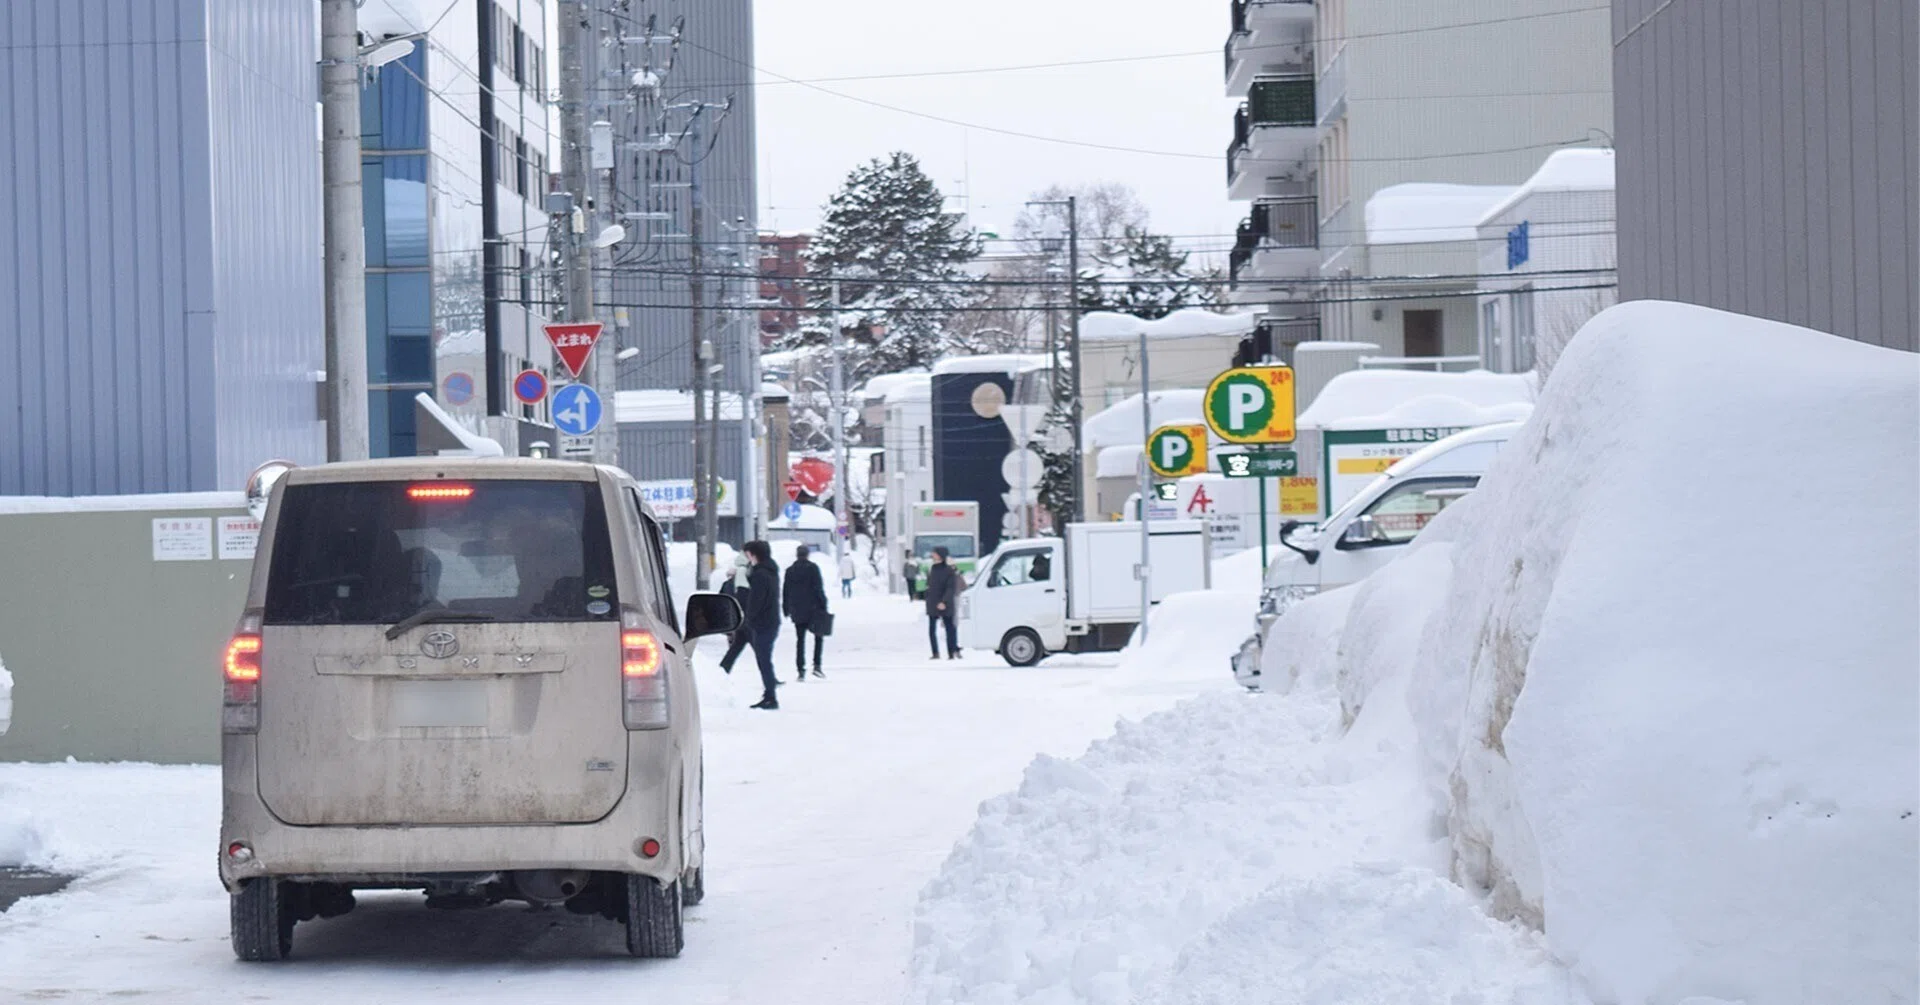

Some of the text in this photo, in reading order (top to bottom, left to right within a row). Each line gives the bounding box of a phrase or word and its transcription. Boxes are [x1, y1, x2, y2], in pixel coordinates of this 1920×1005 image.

[557, 333, 592, 347] 止まれ
[1229, 383, 1265, 430] P
[1162, 436, 1188, 468] P
[1228, 454, 1250, 476] 空
[343, 655, 535, 669] VOXY
